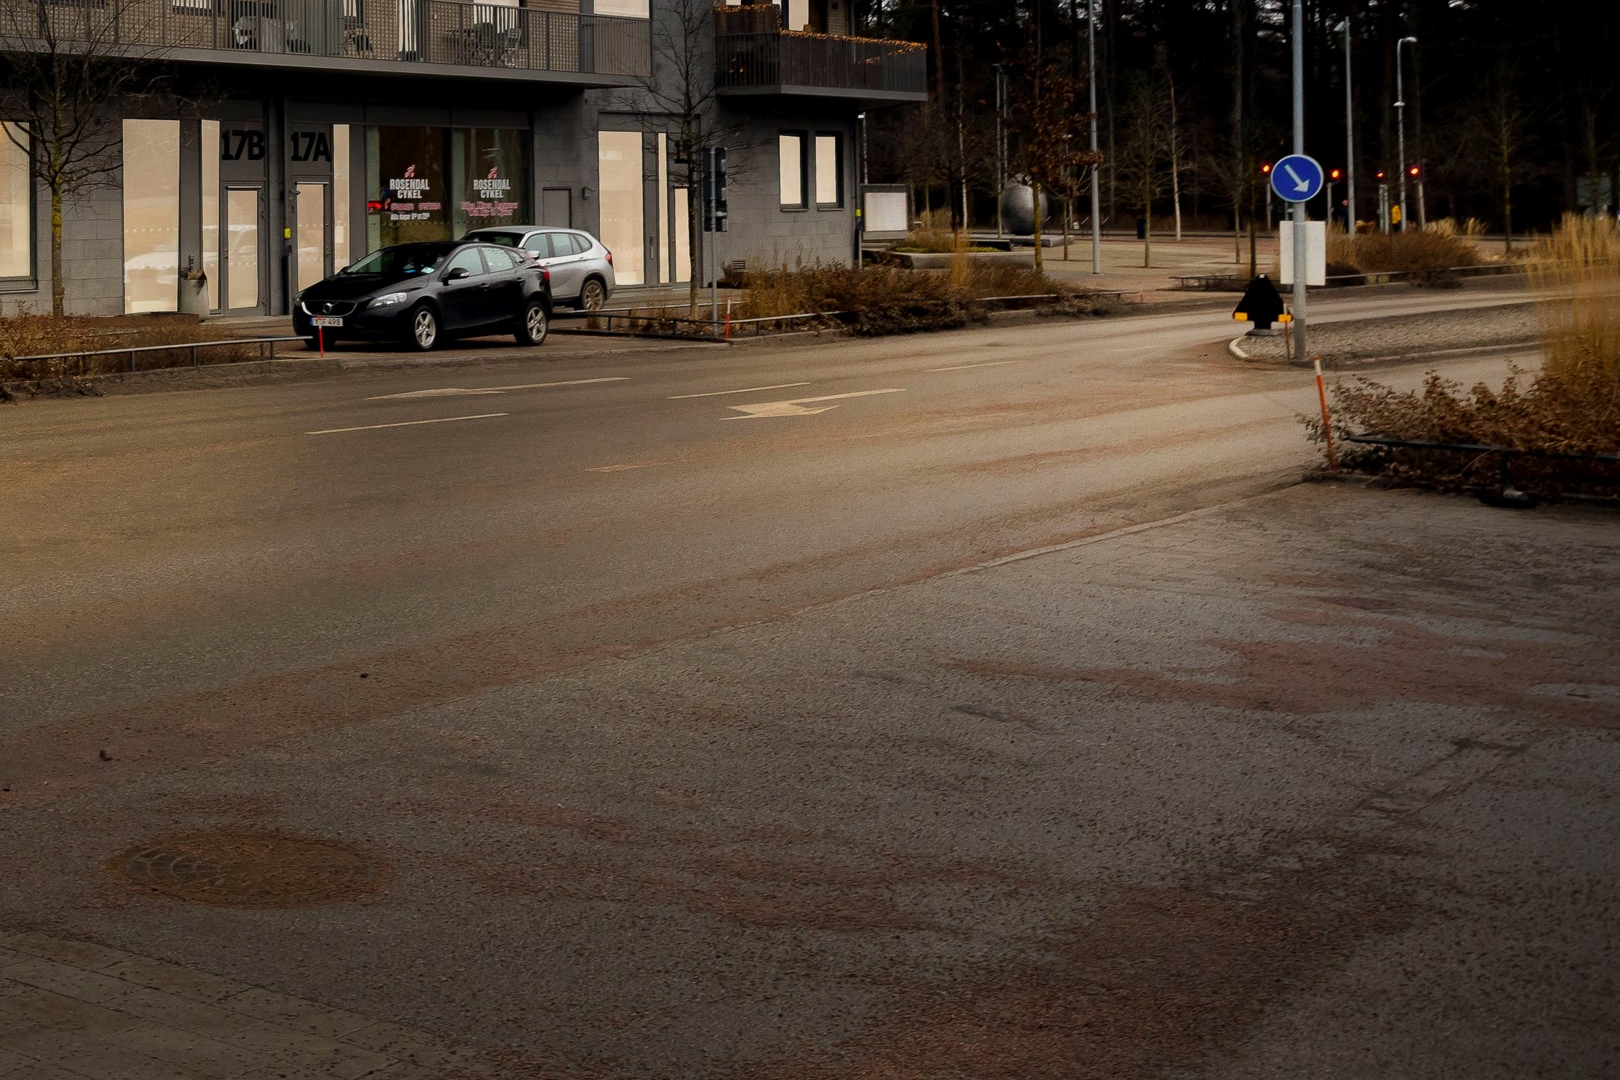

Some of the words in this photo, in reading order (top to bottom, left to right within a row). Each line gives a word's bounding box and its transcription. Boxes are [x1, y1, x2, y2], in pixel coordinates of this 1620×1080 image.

[221, 129, 266, 161] 17B
[290, 131, 333, 162] 17A
[389, 178, 430, 190] ROSENDAL
[473, 179, 511, 190] ROSENDAL
[397, 190, 422, 199] CYKEL
[480, 189, 504, 199] CYKEL
